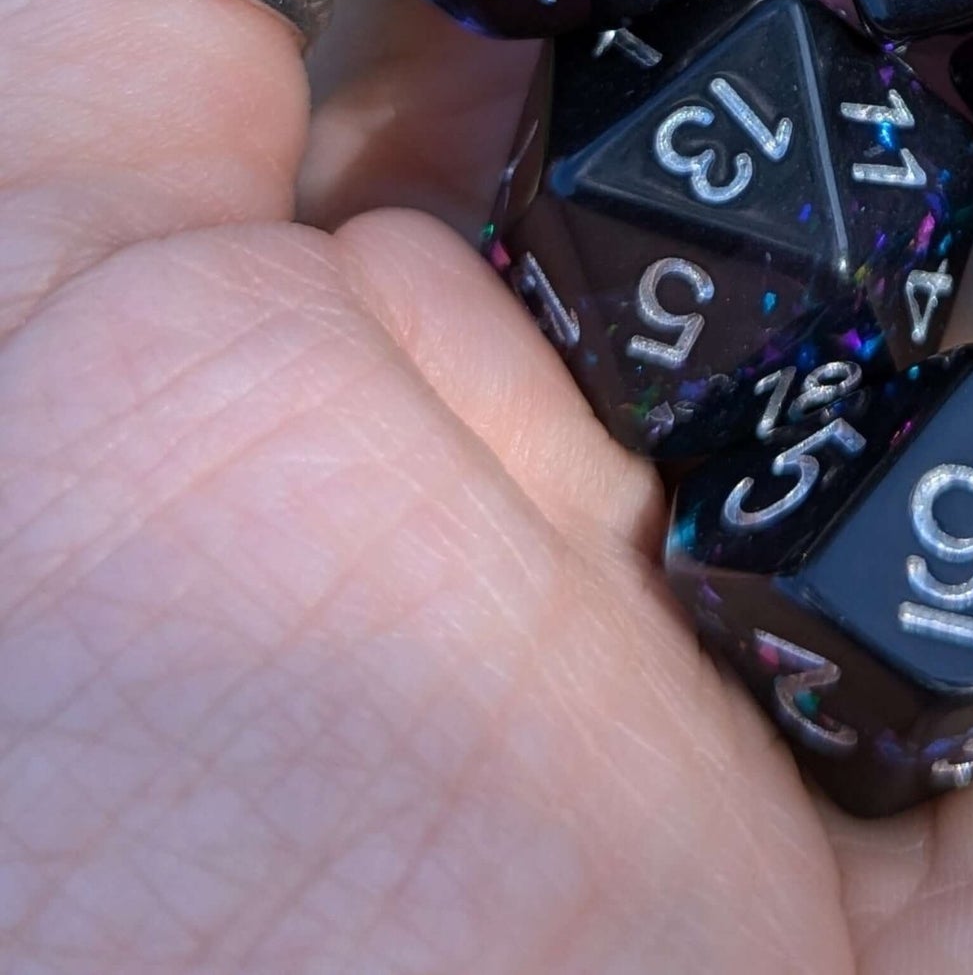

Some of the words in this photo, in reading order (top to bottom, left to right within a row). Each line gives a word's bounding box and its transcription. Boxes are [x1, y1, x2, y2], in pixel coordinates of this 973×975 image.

[652, 77, 793, 204] 13
[840, 89, 927, 186] 11
[626, 257, 715, 368] 5
[905, 258, 953, 344] 4
[722, 417, 867, 526] 5
